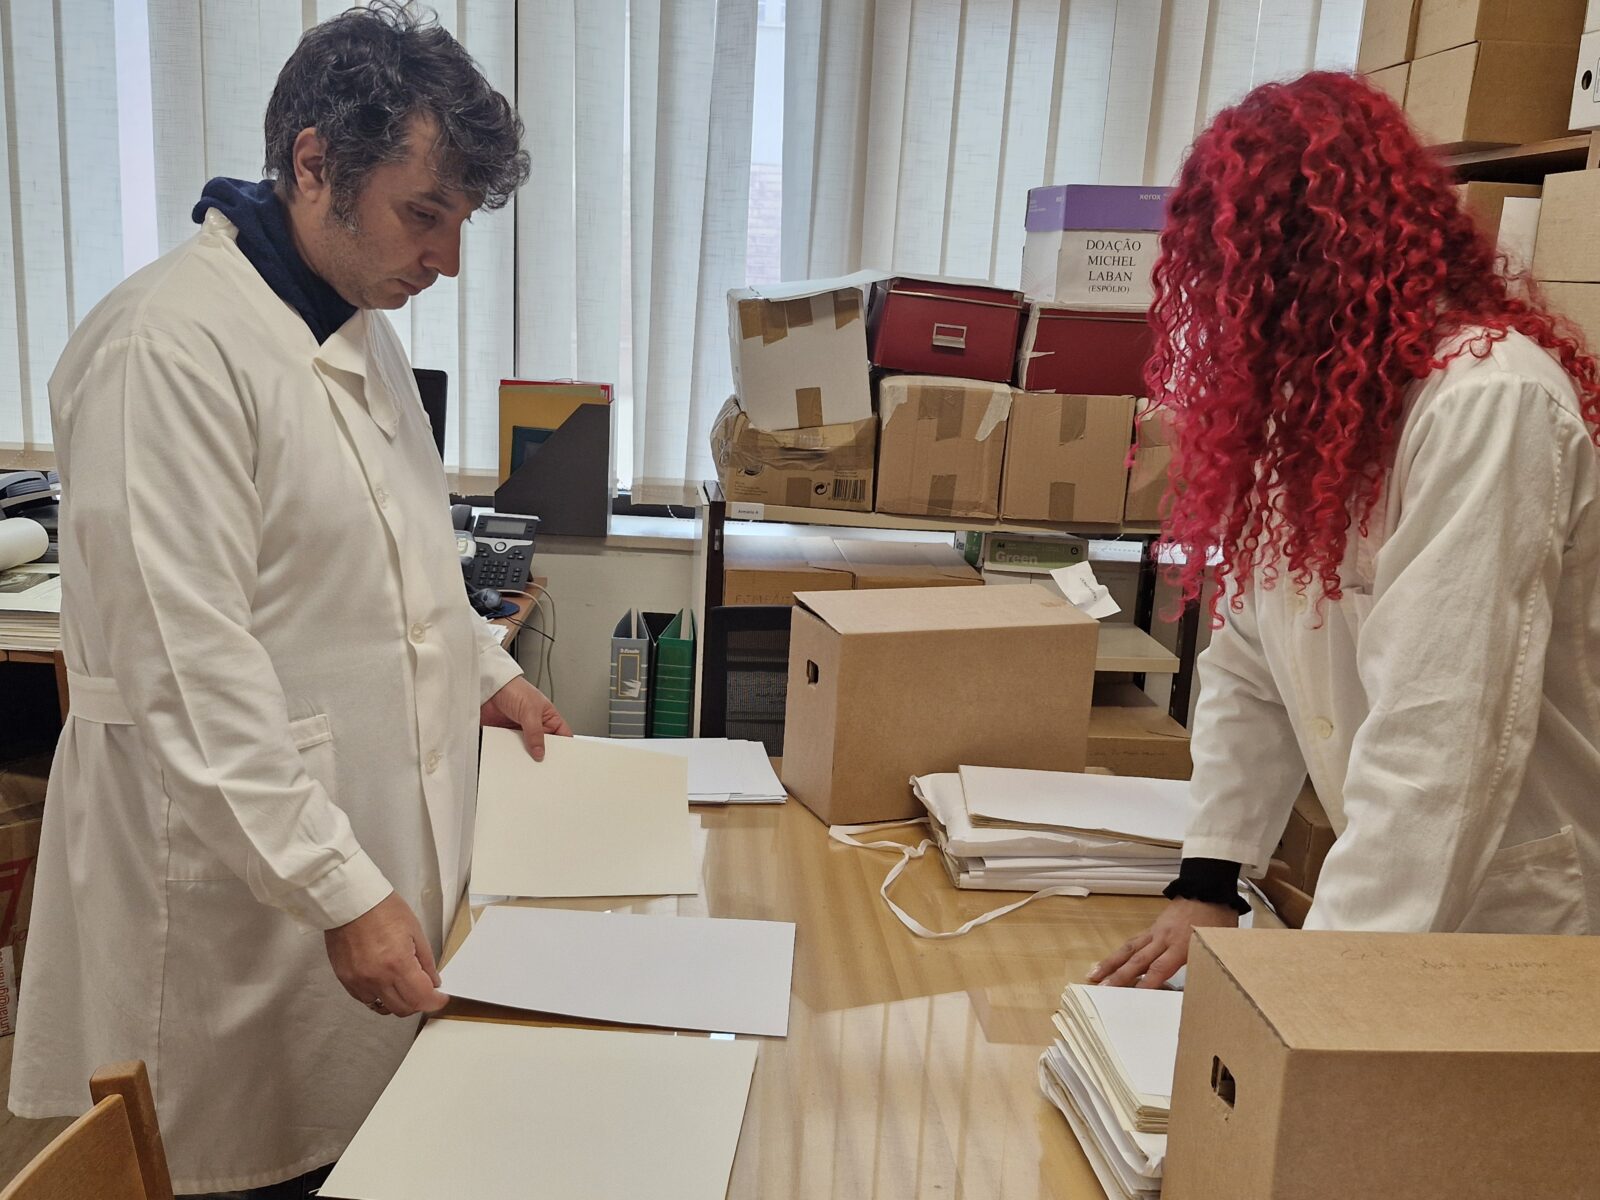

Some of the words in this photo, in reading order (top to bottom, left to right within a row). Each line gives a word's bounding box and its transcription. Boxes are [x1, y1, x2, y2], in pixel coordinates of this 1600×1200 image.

[1139, 193, 1161, 201] xerox
[1086, 238, 1141, 252] DOAÇÃO
[1087, 255, 1136, 267] MICHEL
[1088, 270, 1133, 282] LABAN
[1088, 284, 1130, 294] (ESPÓLIO)
[995, 551, 1038, 565] Green
